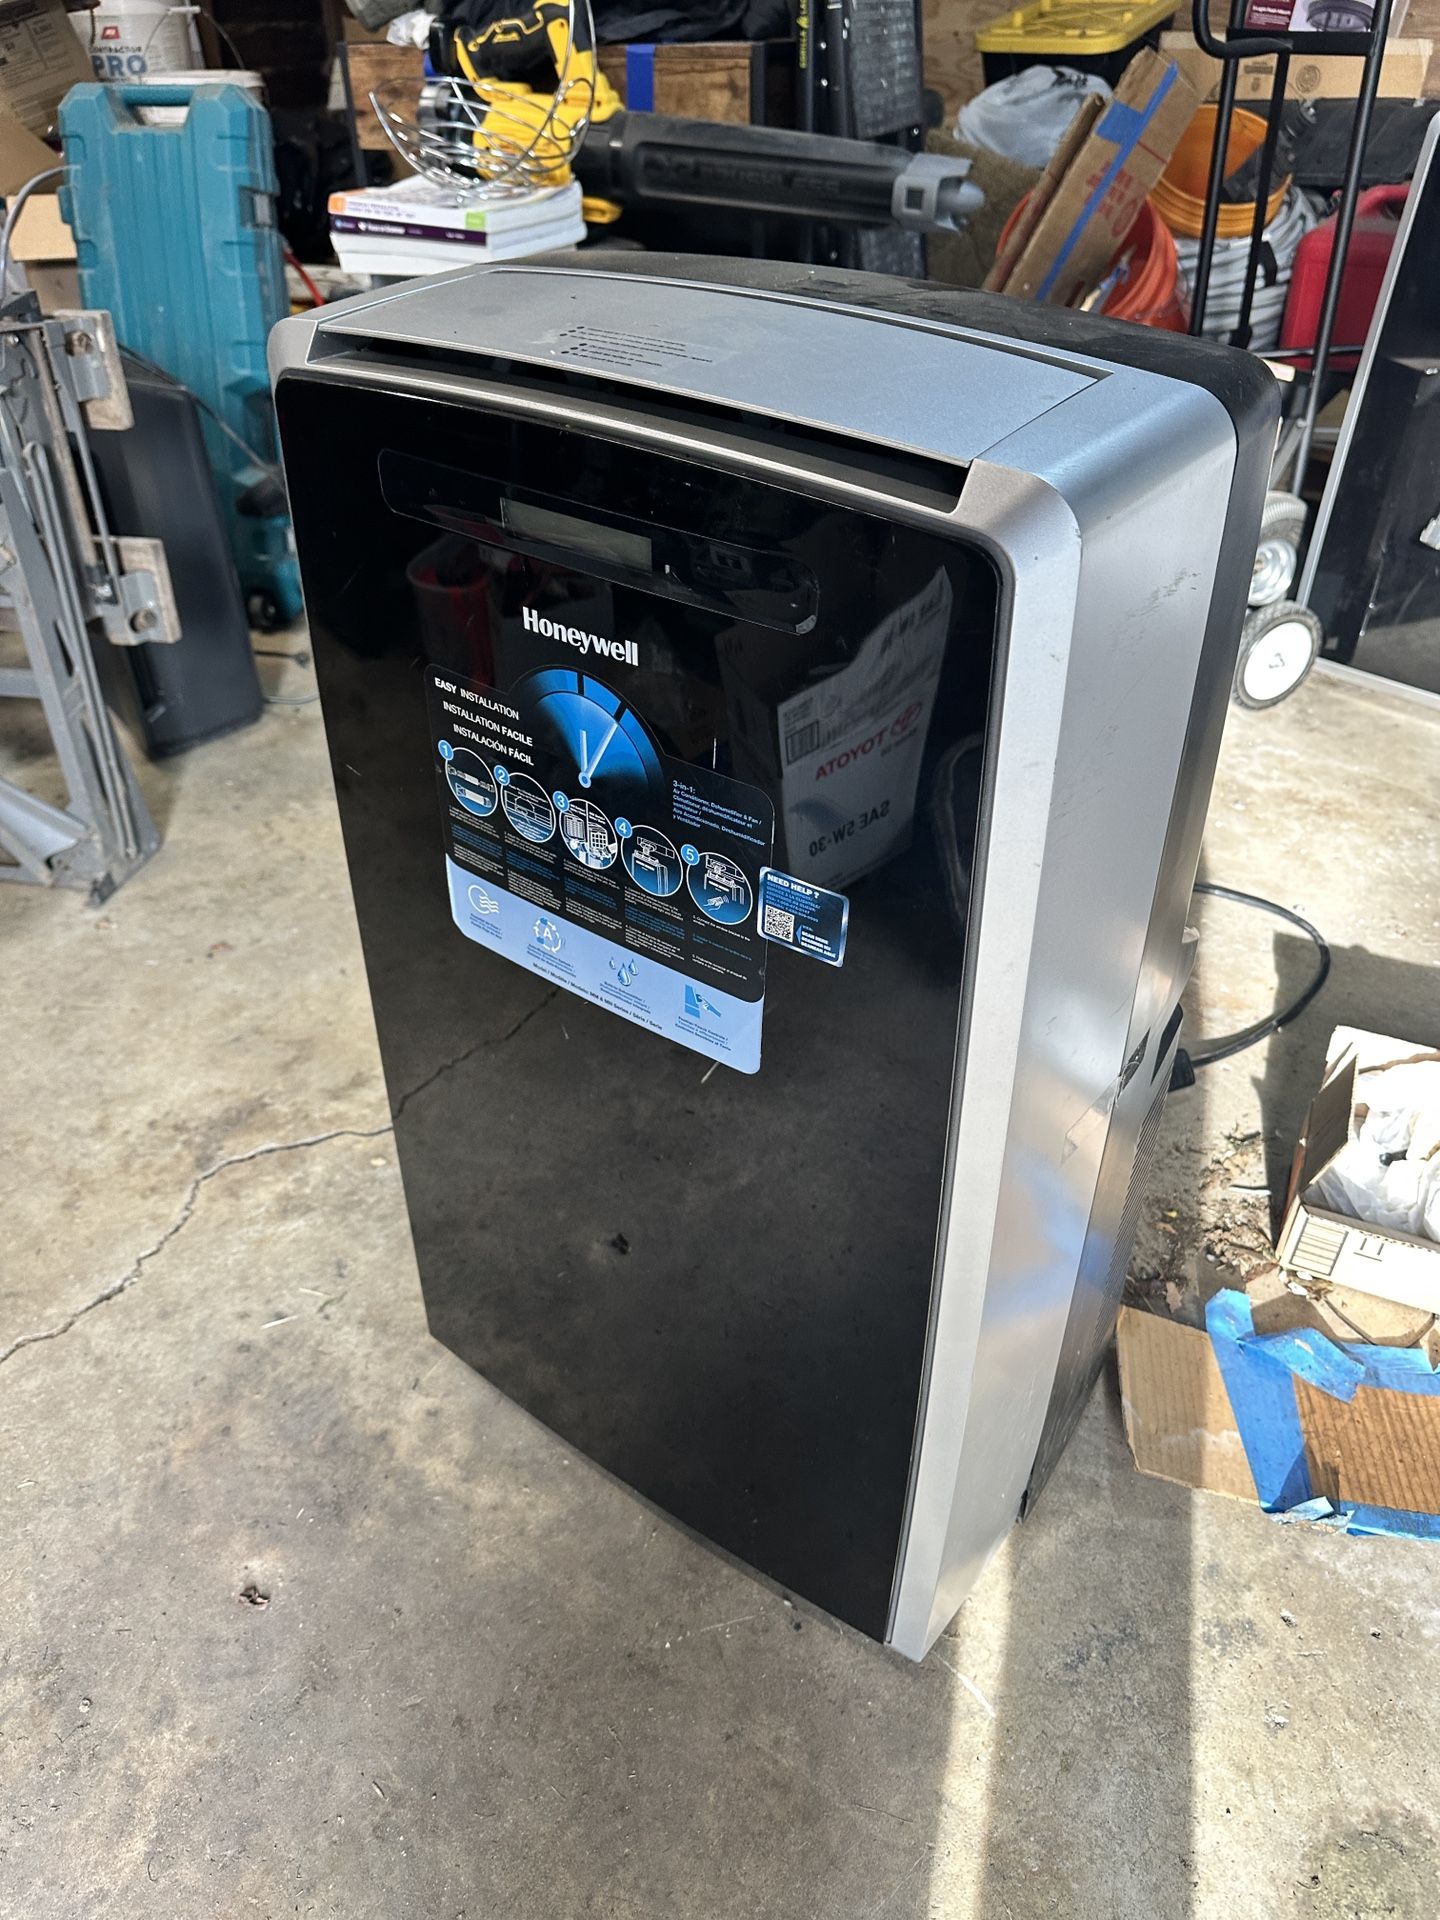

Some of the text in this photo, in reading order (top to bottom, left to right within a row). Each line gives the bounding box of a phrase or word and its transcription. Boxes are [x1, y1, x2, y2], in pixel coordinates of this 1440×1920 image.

[92, 55, 147, 77] PRO
[522, 606, 639, 667] Honeywell
[434, 677, 519, 720] EASY INSTALLATION
[443, 701, 533, 746] INSTALLATION FACILE
[442, 745, 448, 756] 1
[453, 724, 534, 765] INSTALACIÓN FÁCIL
[498, 769, 507, 782] 2
[672, 779, 696, 794] 3-in-1:
[557, 795, 565, 807] 3
[618, 821, 627, 835] 4
[686, 848, 695, 861] 5
[767, 873, 789, 888] NEED
[791, 882, 812, 897] HELP
